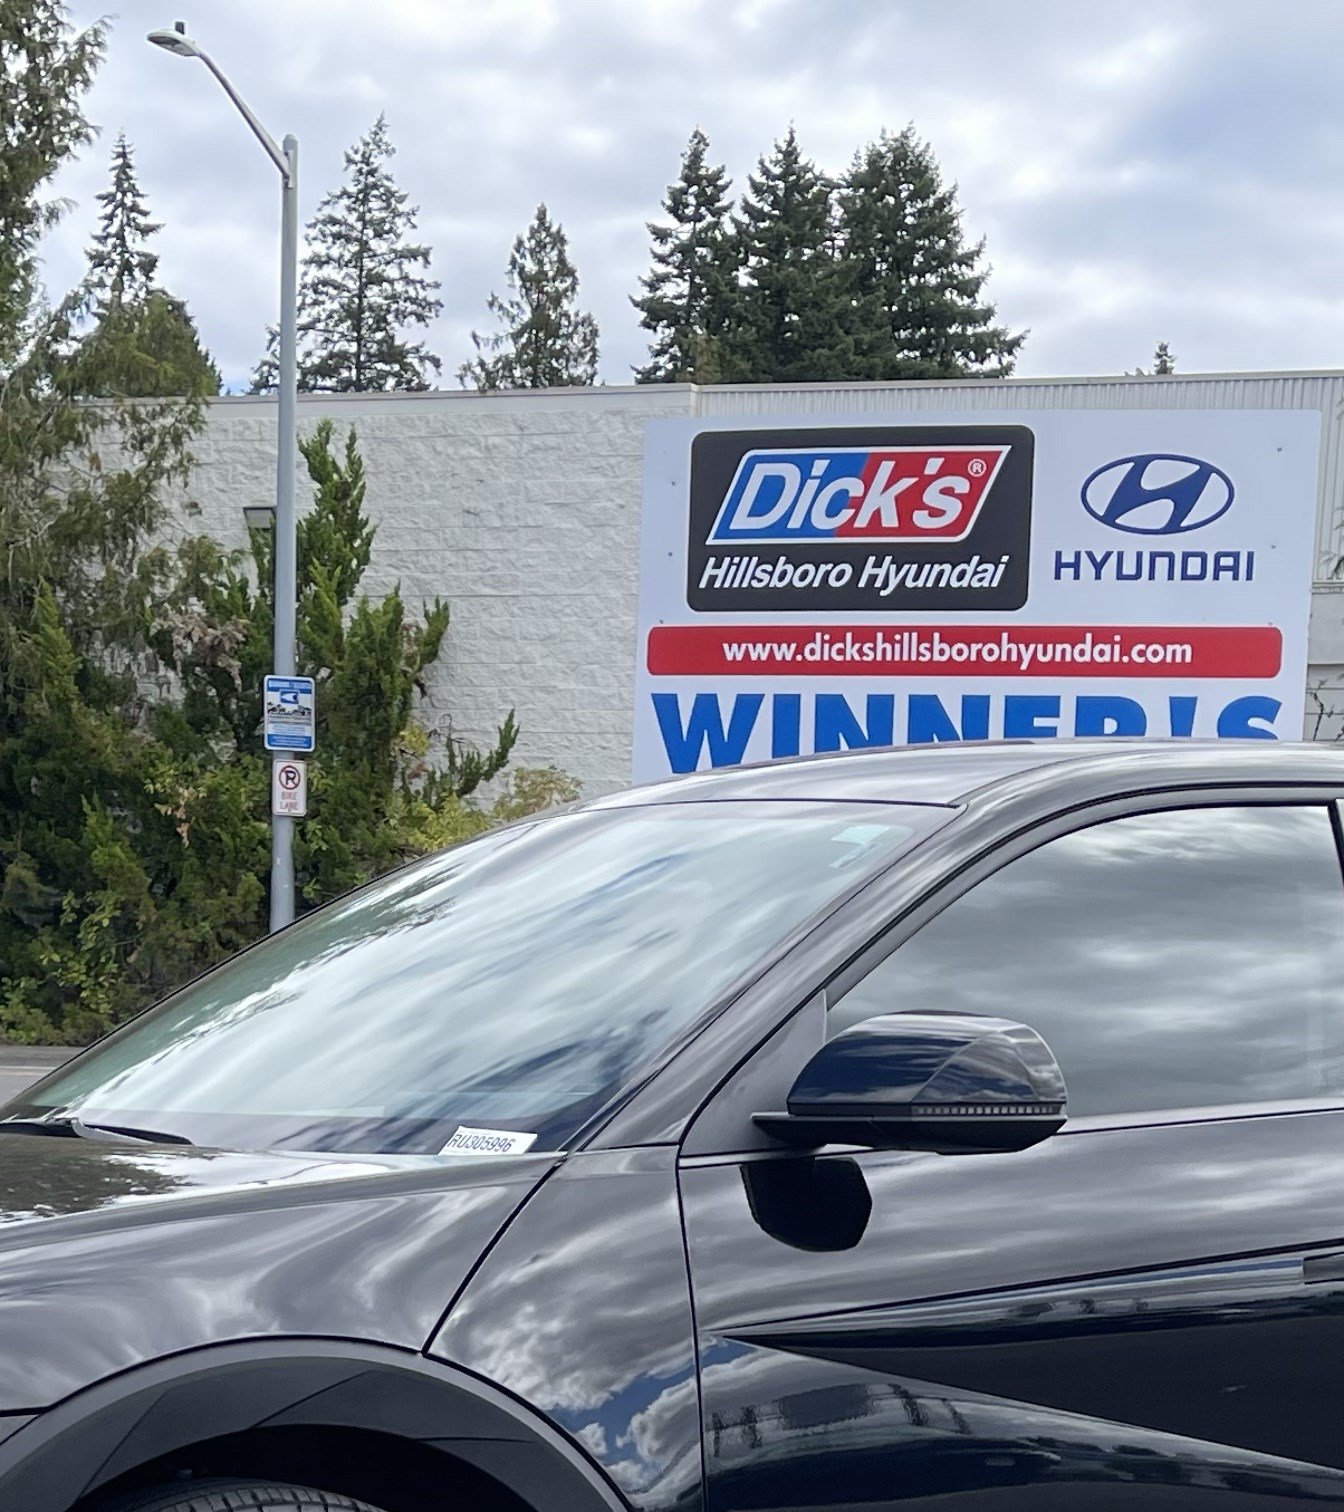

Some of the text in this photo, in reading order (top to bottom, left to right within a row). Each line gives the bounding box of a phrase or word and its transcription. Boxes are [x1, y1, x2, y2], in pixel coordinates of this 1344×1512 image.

[729, 457, 970, 530] Dick's
[698, 553, 1011, 598] Hillsboro Hyundai
[1054, 550, 1255, 582] HYUNDAI
[722, 633, 1193, 671] www.dickshillsborohyundai.com
